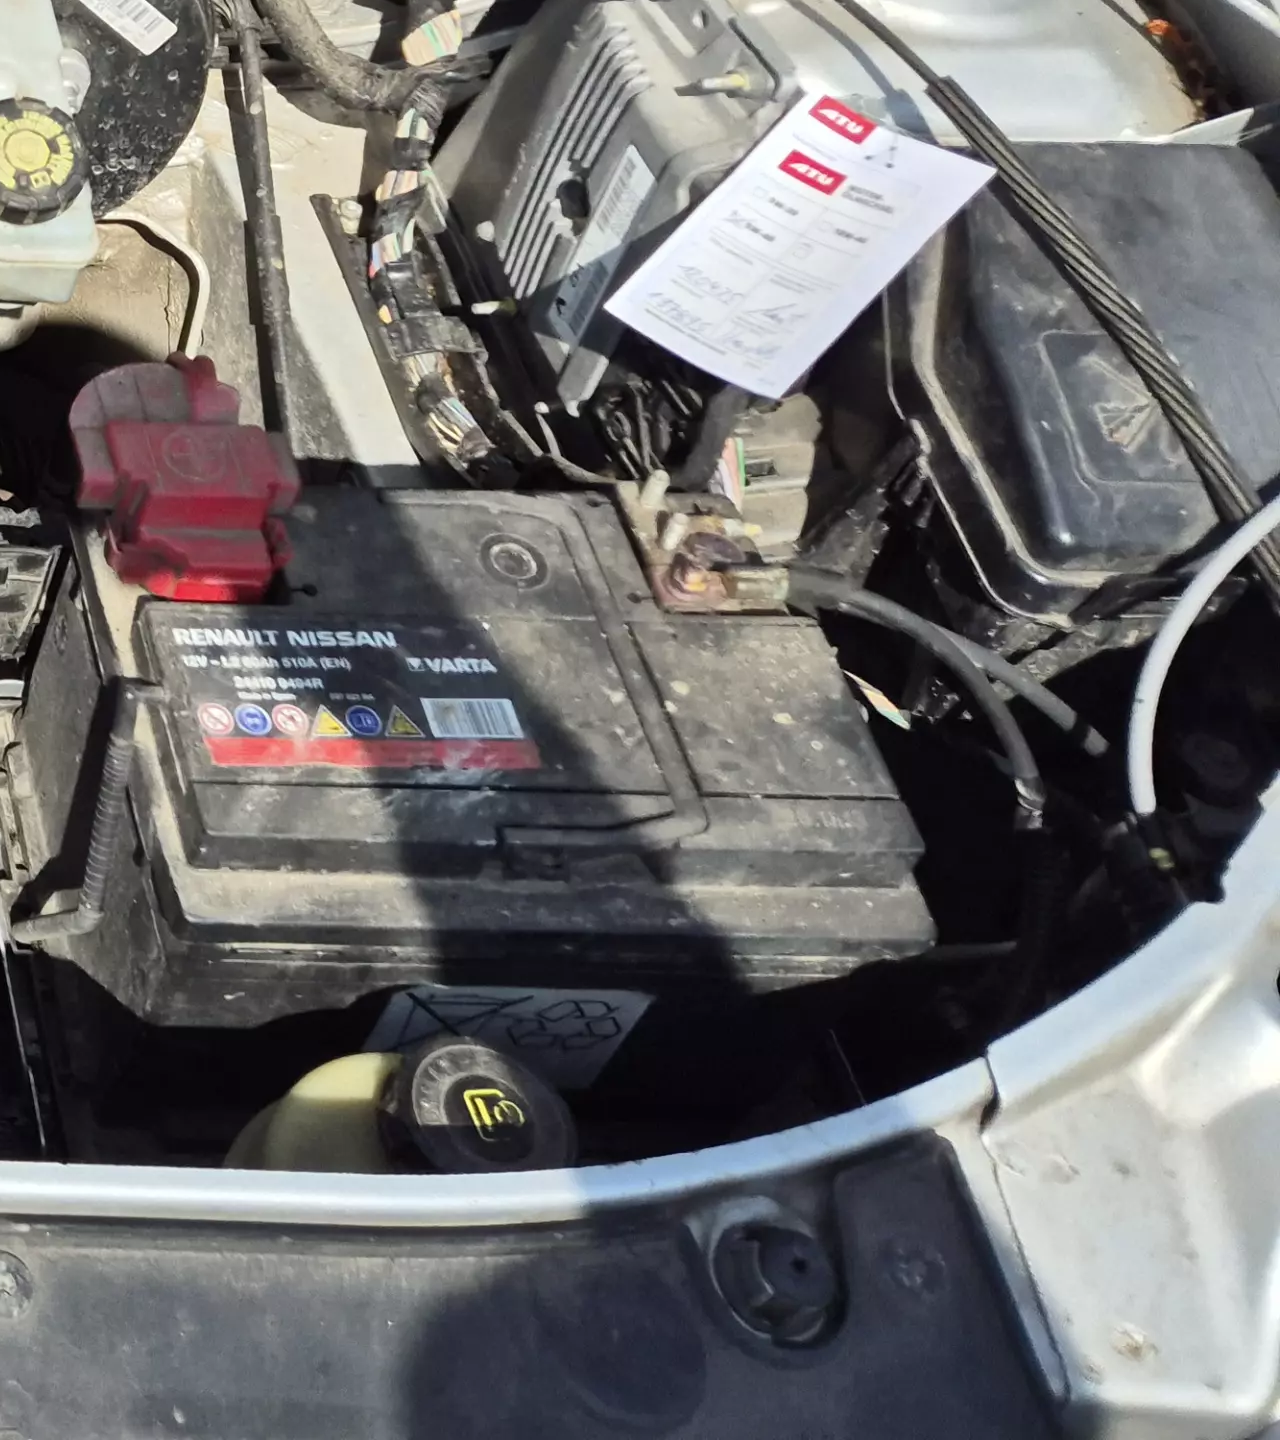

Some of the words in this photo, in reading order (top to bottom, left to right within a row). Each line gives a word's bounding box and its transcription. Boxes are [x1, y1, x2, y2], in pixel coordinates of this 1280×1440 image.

[173, 628, 278, 646] RENAULT
[286, 630, 397, 648] NISSAN
[319, 656, 353, 671] (EN)
[424, 657, 498, 674] VARTA
